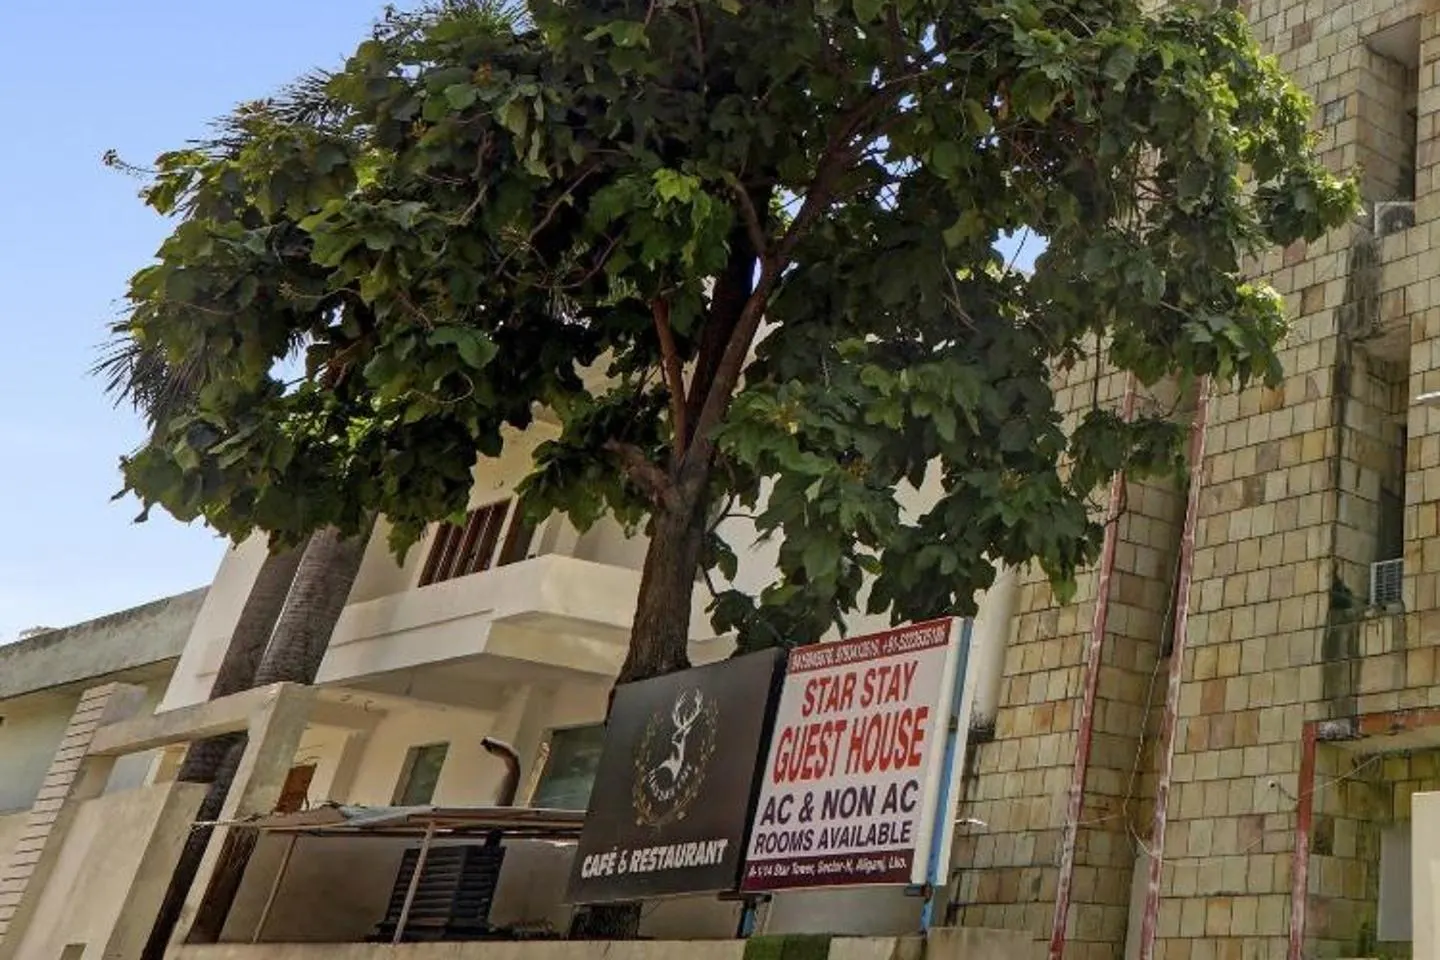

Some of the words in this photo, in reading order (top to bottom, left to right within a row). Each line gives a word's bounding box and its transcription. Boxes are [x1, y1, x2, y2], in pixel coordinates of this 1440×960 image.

[802, 672, 857, 717] STAR
[860, 660, 918, 708] STAY
[773, 720, 847, 785] GUEST
[845, 706, 929, 775] HOUSE
[760, 794, 794, 826] AC
[798, 792, 815, 823] &
[820, 785, 876, 820] NON
[881, 780, 919, 814] AC
[581, 846, 618, 879] CAFÉ
[629, 838, 728, 873] RESTAURANT
[754, 827, 815, 855] ROOMS
[817, 820, 913, 850] AVAILABLE
